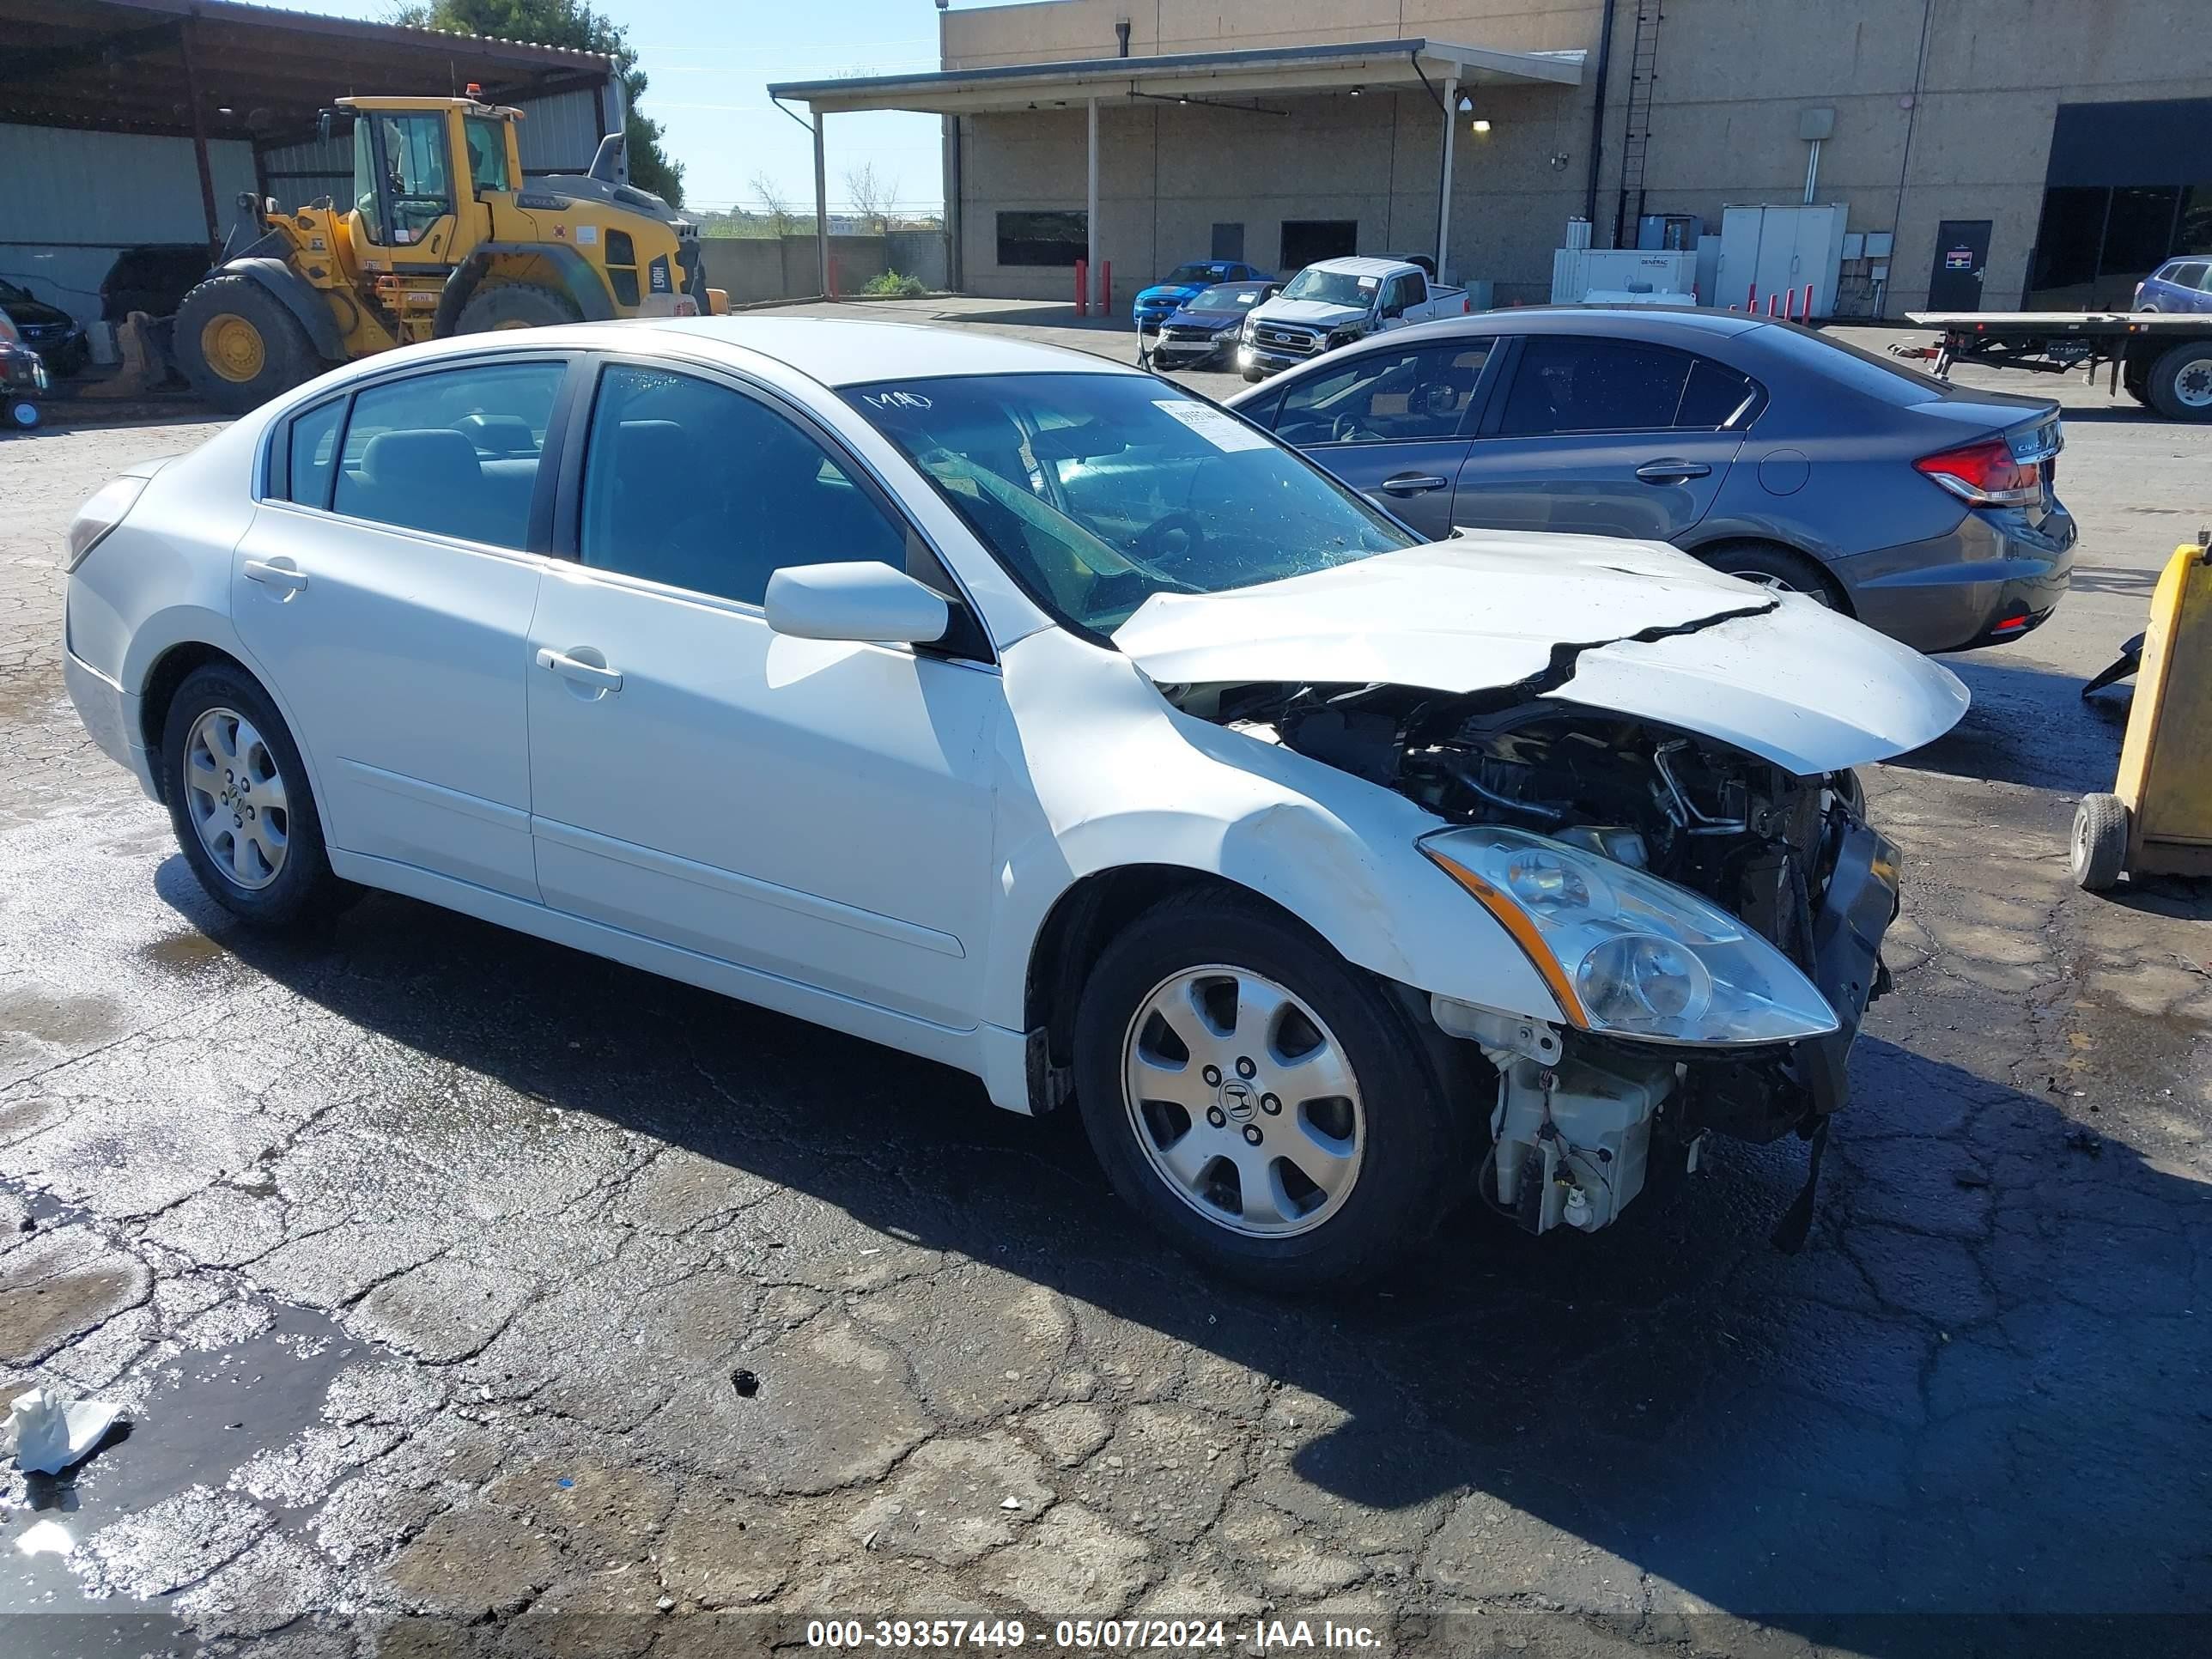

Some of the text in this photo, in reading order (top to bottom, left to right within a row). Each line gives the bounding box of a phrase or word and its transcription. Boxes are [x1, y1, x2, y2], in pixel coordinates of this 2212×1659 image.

[523, 198, 567, 207] VOLVO
[653, 266, 665, 289] L90H
[2018, 441, 2040, 452] CIVIC
